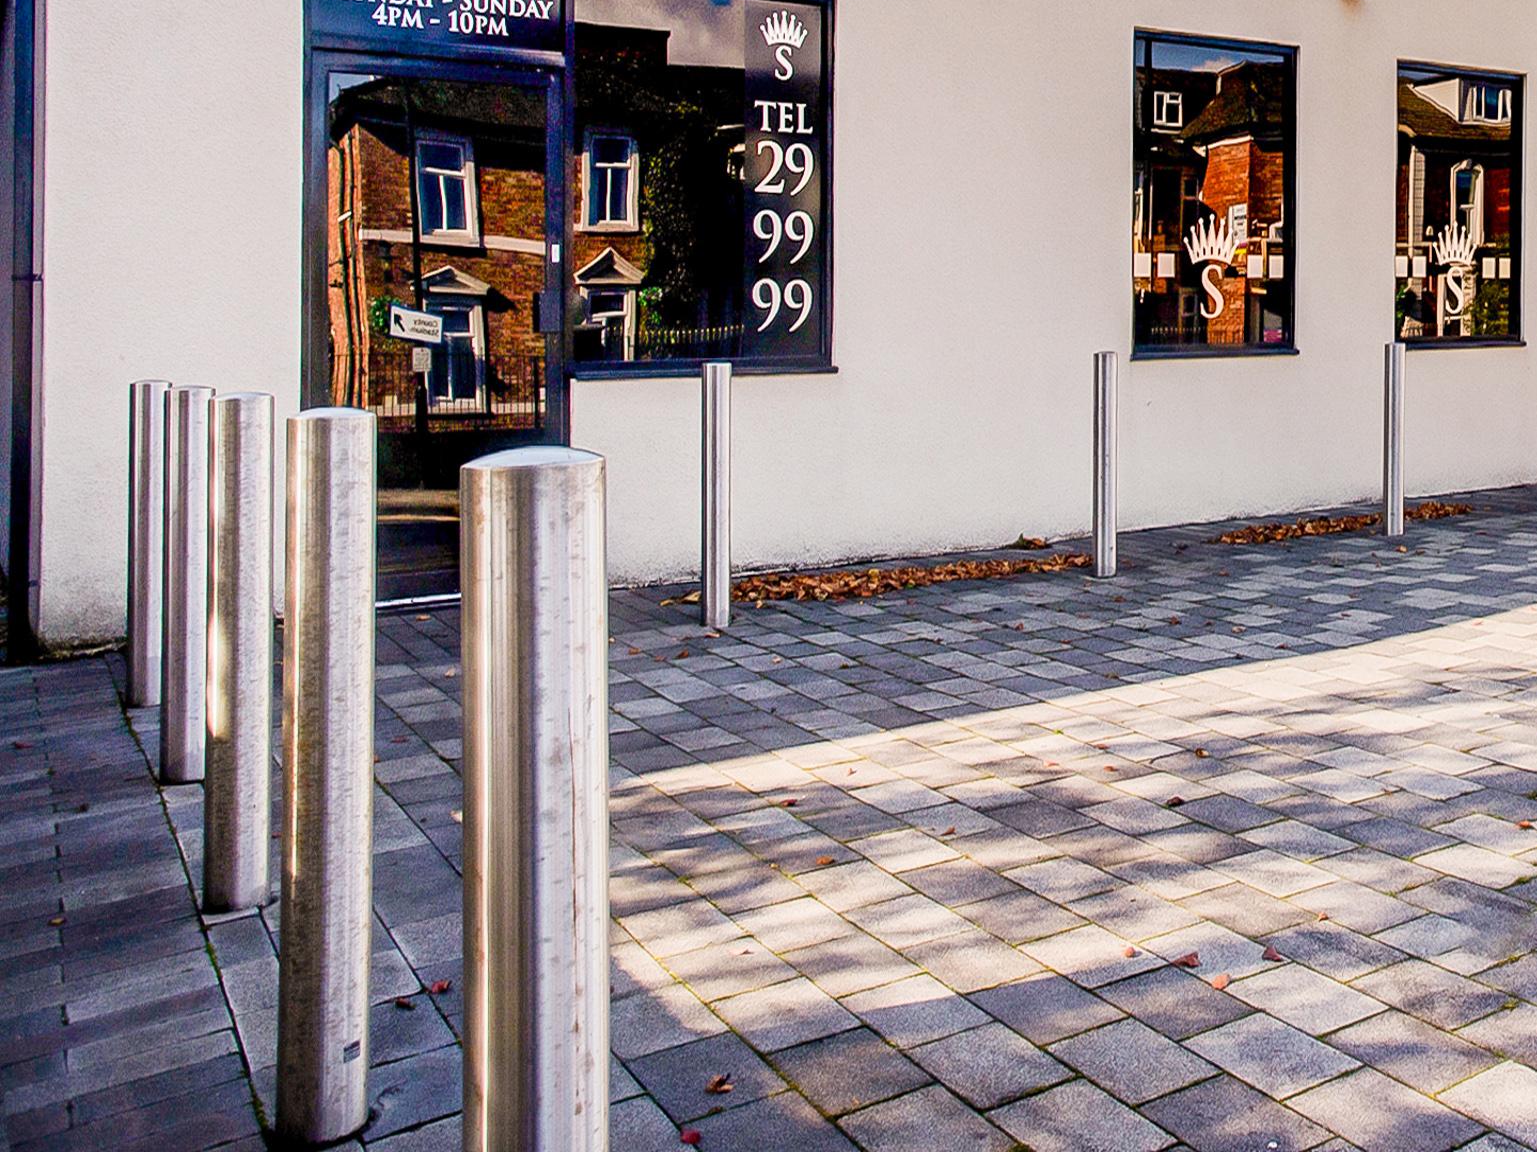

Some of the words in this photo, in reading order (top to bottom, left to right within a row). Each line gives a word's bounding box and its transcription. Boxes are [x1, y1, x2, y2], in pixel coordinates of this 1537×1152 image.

[371, 3, 424, 29] 4PM
[448, 9, 509, 36] 10PM
[774, 45, 794, 81] S
[754, 100, 813, 135] TEL
[754, 140, 815, 197] 29
[752, 209, 815, 264] 99
[751, 277, 814, 333] 99
[1199, 263, 1225, 319] S
[1445, 266, 1465, 315] S
